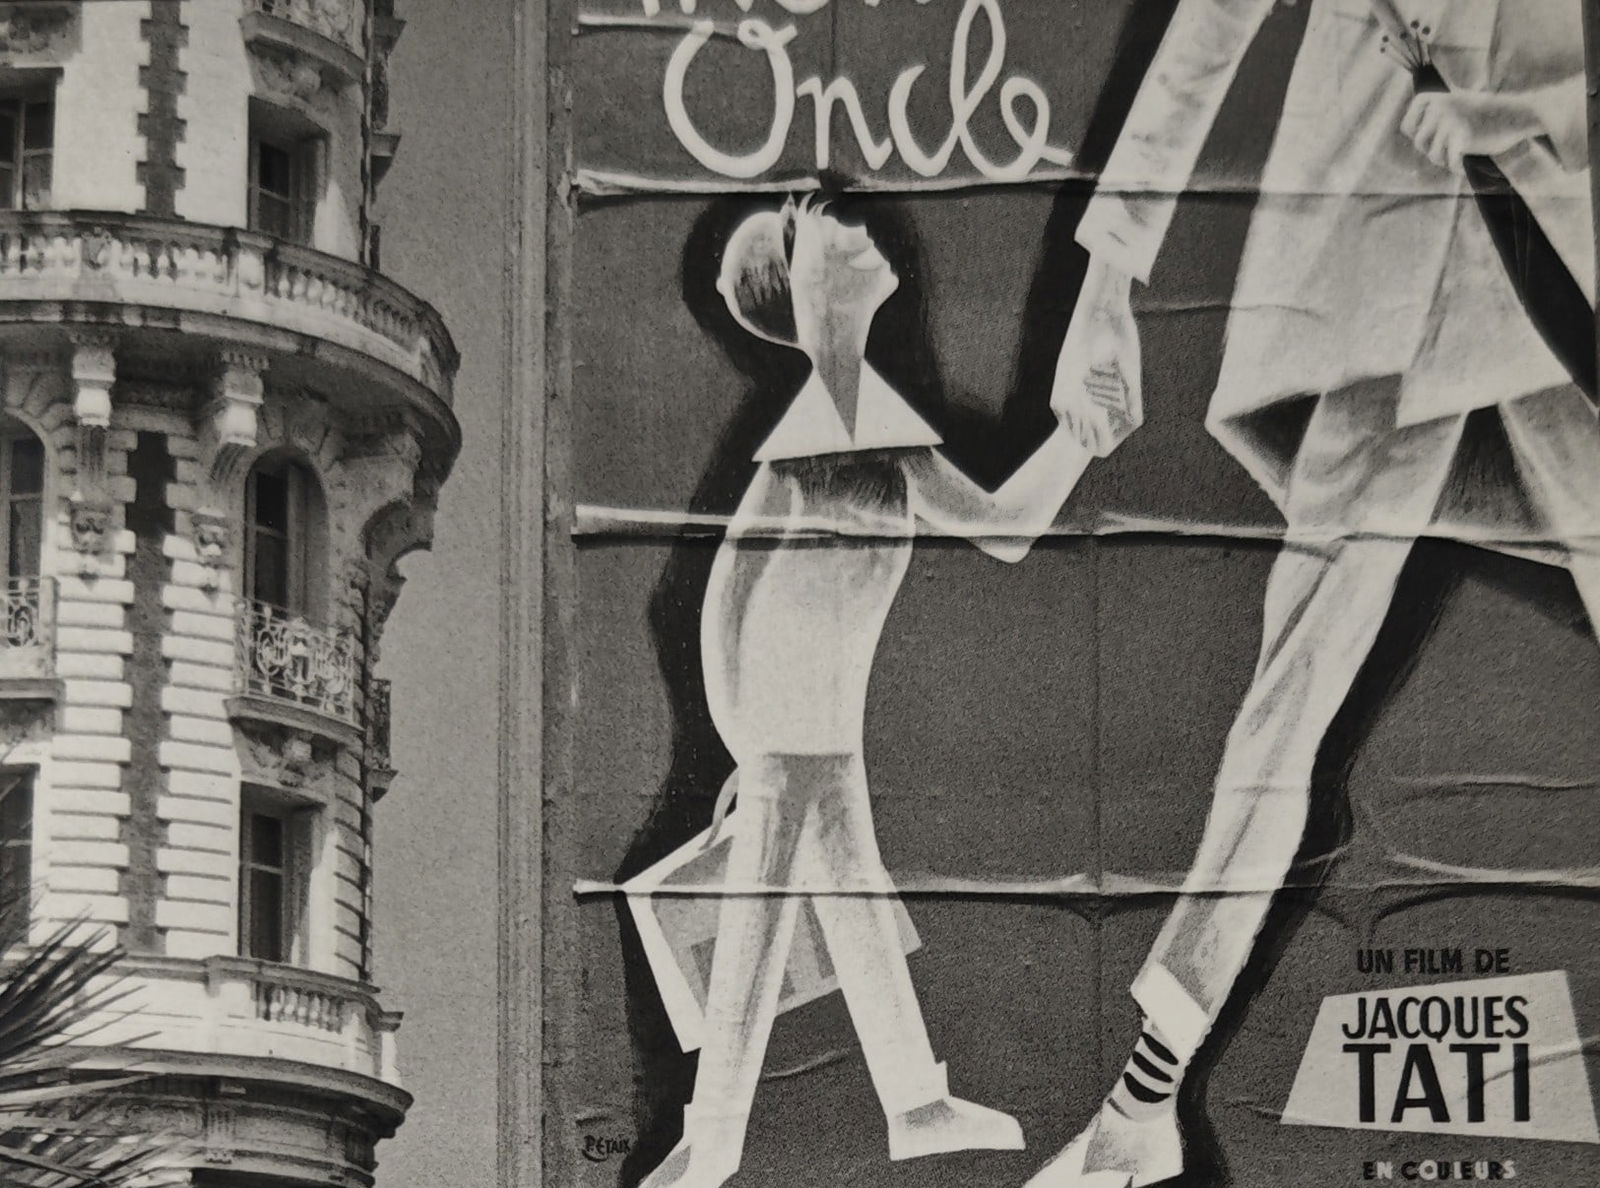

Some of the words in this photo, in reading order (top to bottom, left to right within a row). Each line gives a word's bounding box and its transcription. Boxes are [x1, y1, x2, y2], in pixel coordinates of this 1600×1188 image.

[664, 0, 1075, 178] Oncle
[1357, 949, 1393, 974] UN
[1404, 949, 1463, 974] FILM
[1475, 948, 1510, 974] DE
[1342, 996, 1529, 1043] JACQUES
[1342, 1043, 1530, 1123] TATI
[1363, 1161, 1393, 1180] EN
[1401, 1159, 1517, 1180] COULEURS
